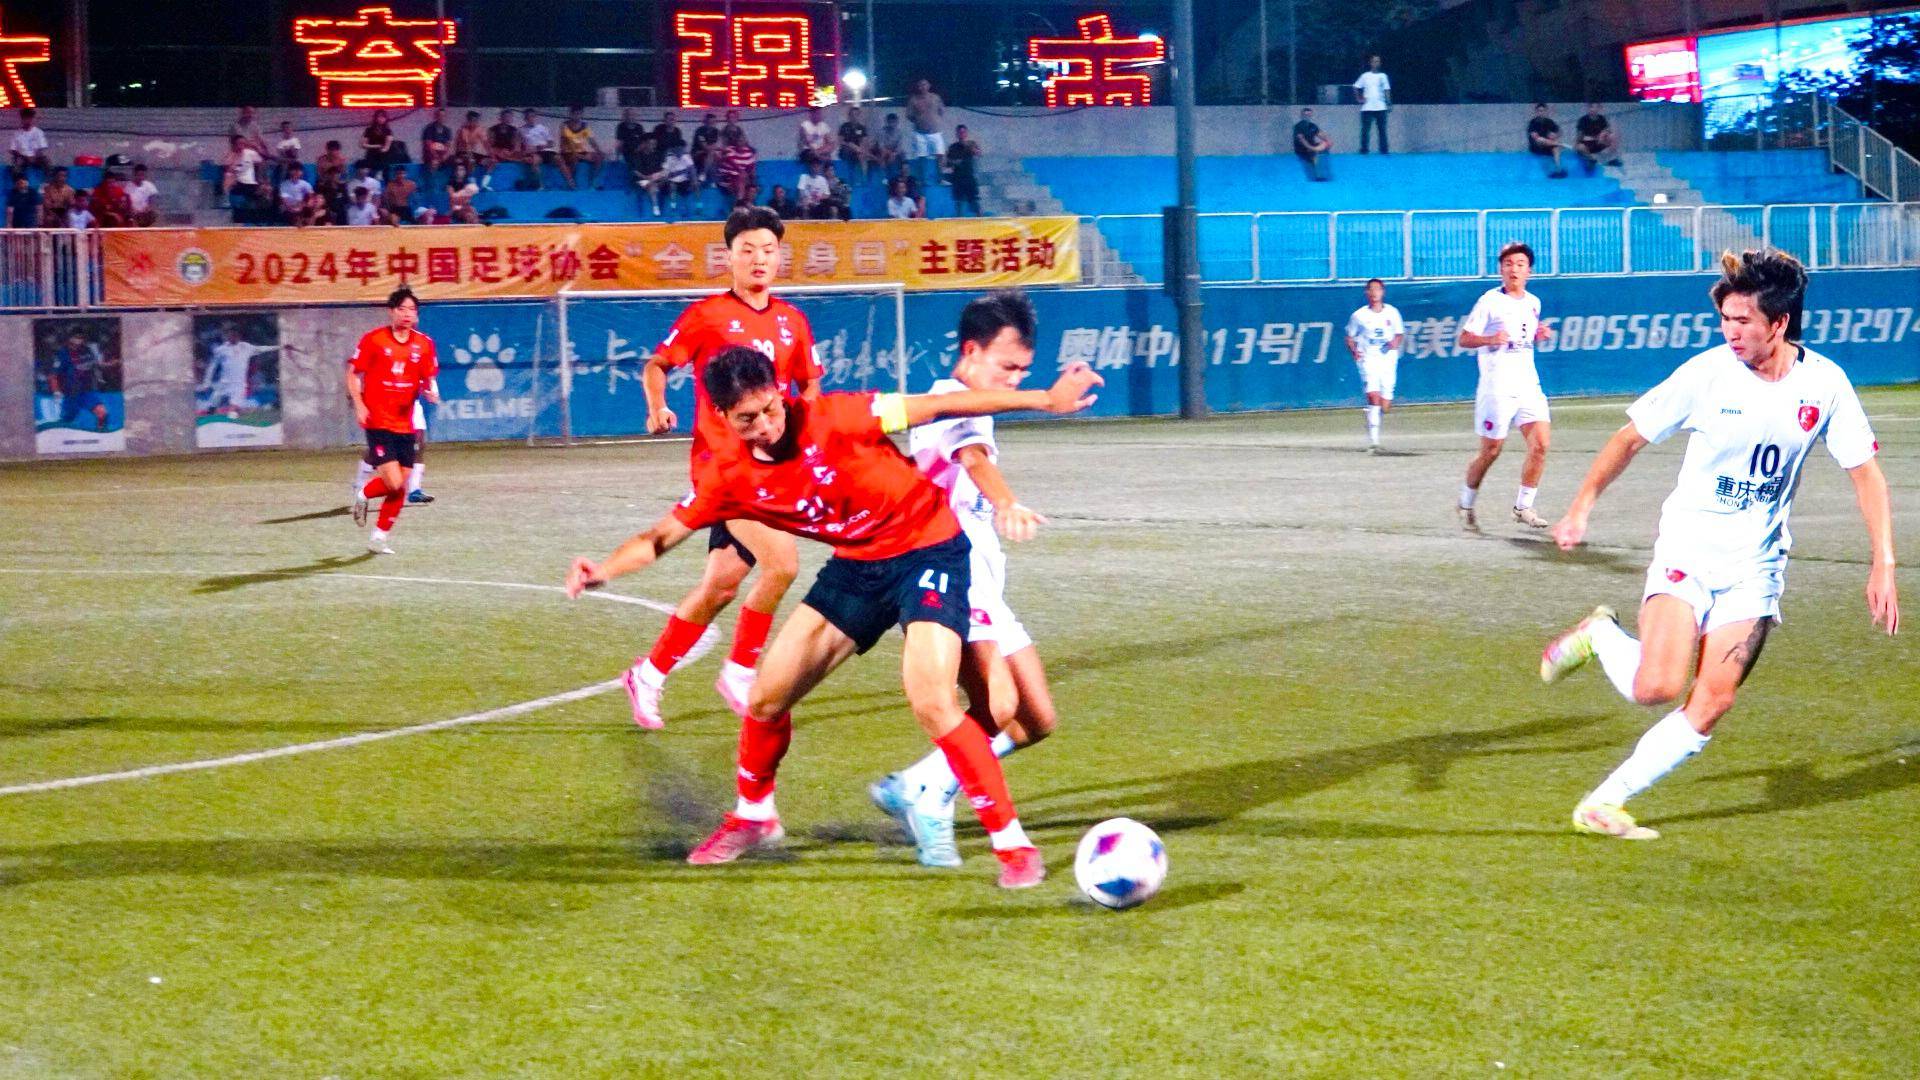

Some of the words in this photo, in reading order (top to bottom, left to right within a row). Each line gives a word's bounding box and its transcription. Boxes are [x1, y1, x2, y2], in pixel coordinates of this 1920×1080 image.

[1056, 322, 1334, 371] 奥体中13号门
[434, 398, 537, 419] KELME
[1750, 443, 1780, 478] 10
